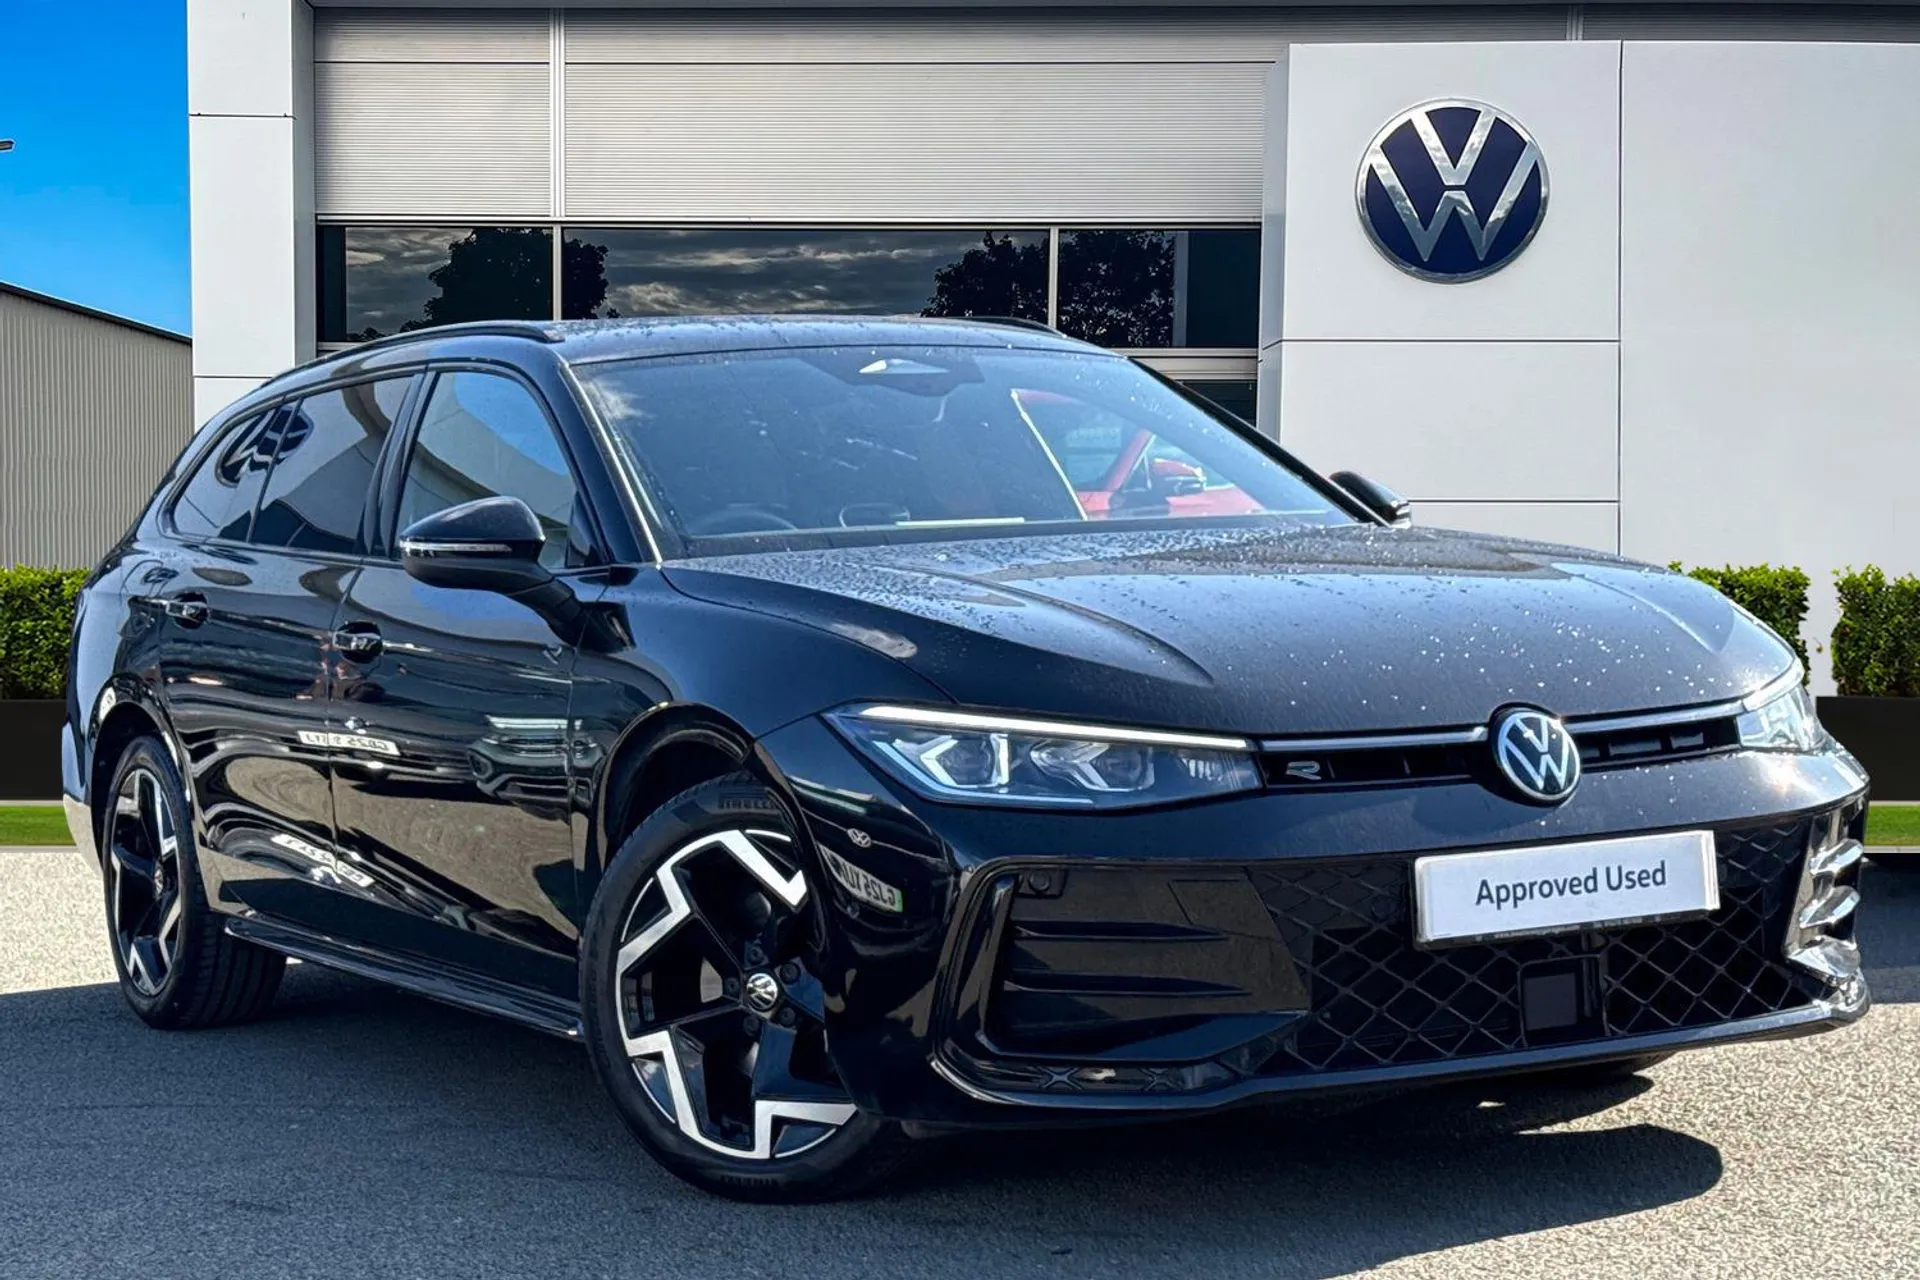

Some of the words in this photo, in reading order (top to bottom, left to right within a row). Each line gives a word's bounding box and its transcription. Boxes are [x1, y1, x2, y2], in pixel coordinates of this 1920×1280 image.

[1358, 100, 1547, 278] VW
[1500, 712, 1577, 796] VW
[1475, 866, 1598, 910] Approved
[1605, 859, 1667, 892] Used
